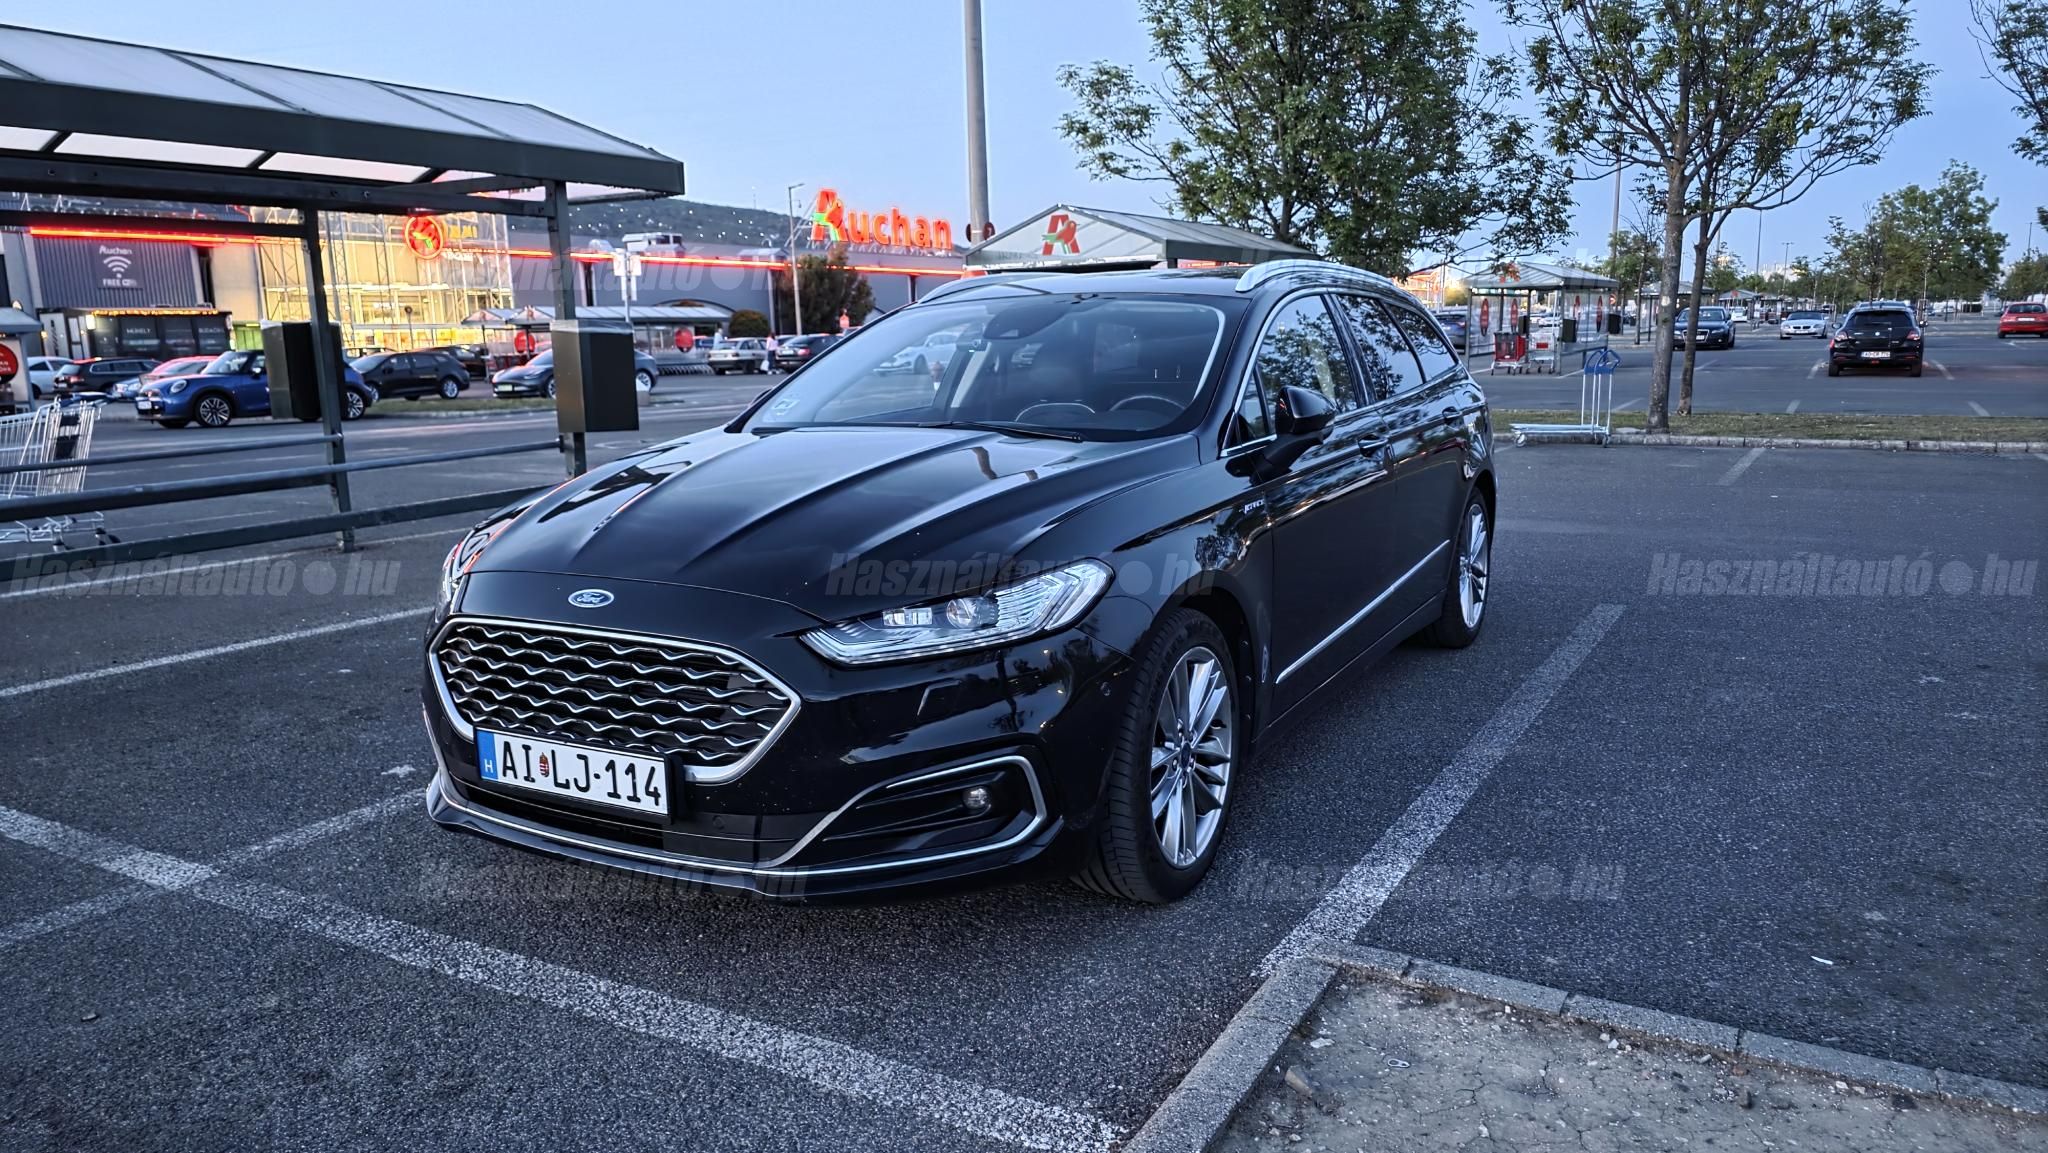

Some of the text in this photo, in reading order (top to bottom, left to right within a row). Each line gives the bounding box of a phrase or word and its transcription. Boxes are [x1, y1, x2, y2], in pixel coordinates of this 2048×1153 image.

[809, 188, 952, 250] Auchan
[484, 758, 494, 774] H
[502, 740, 536, 783] AI
